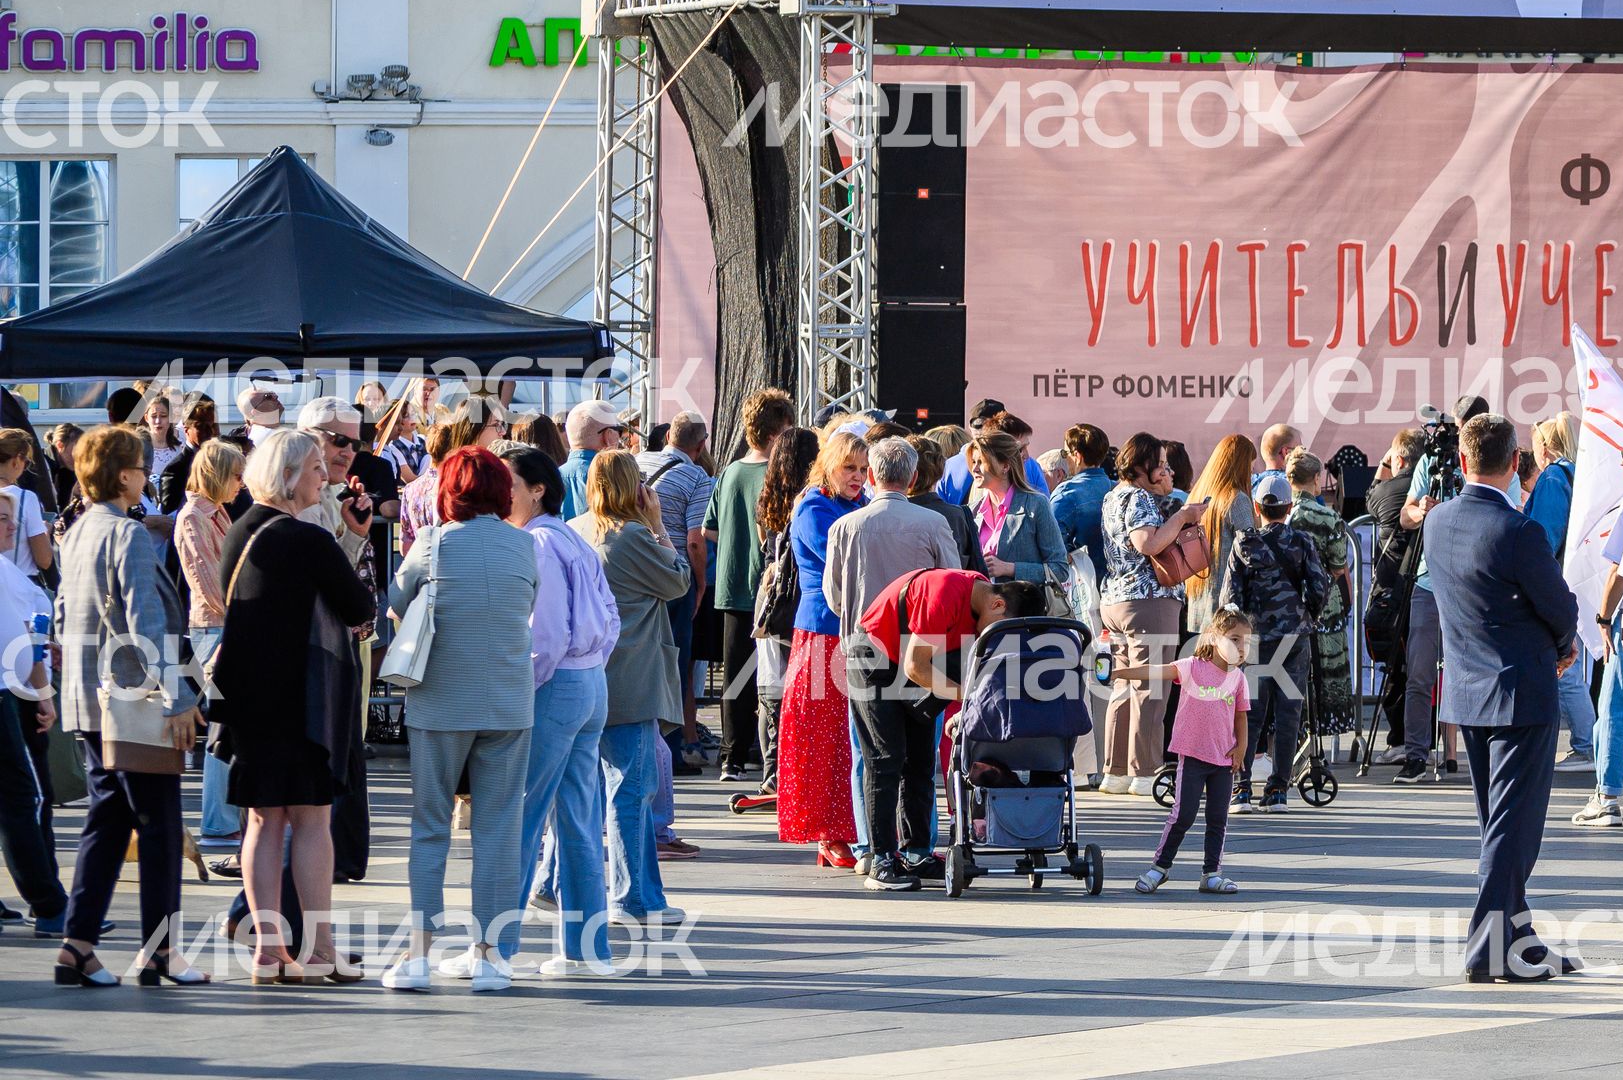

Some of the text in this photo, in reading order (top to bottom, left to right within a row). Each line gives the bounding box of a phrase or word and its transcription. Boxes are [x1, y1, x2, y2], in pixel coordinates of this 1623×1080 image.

[0, 12, 260, 71] familia
[1033, 370, 1254, 398] ПЁТР ФОМЕНКО
